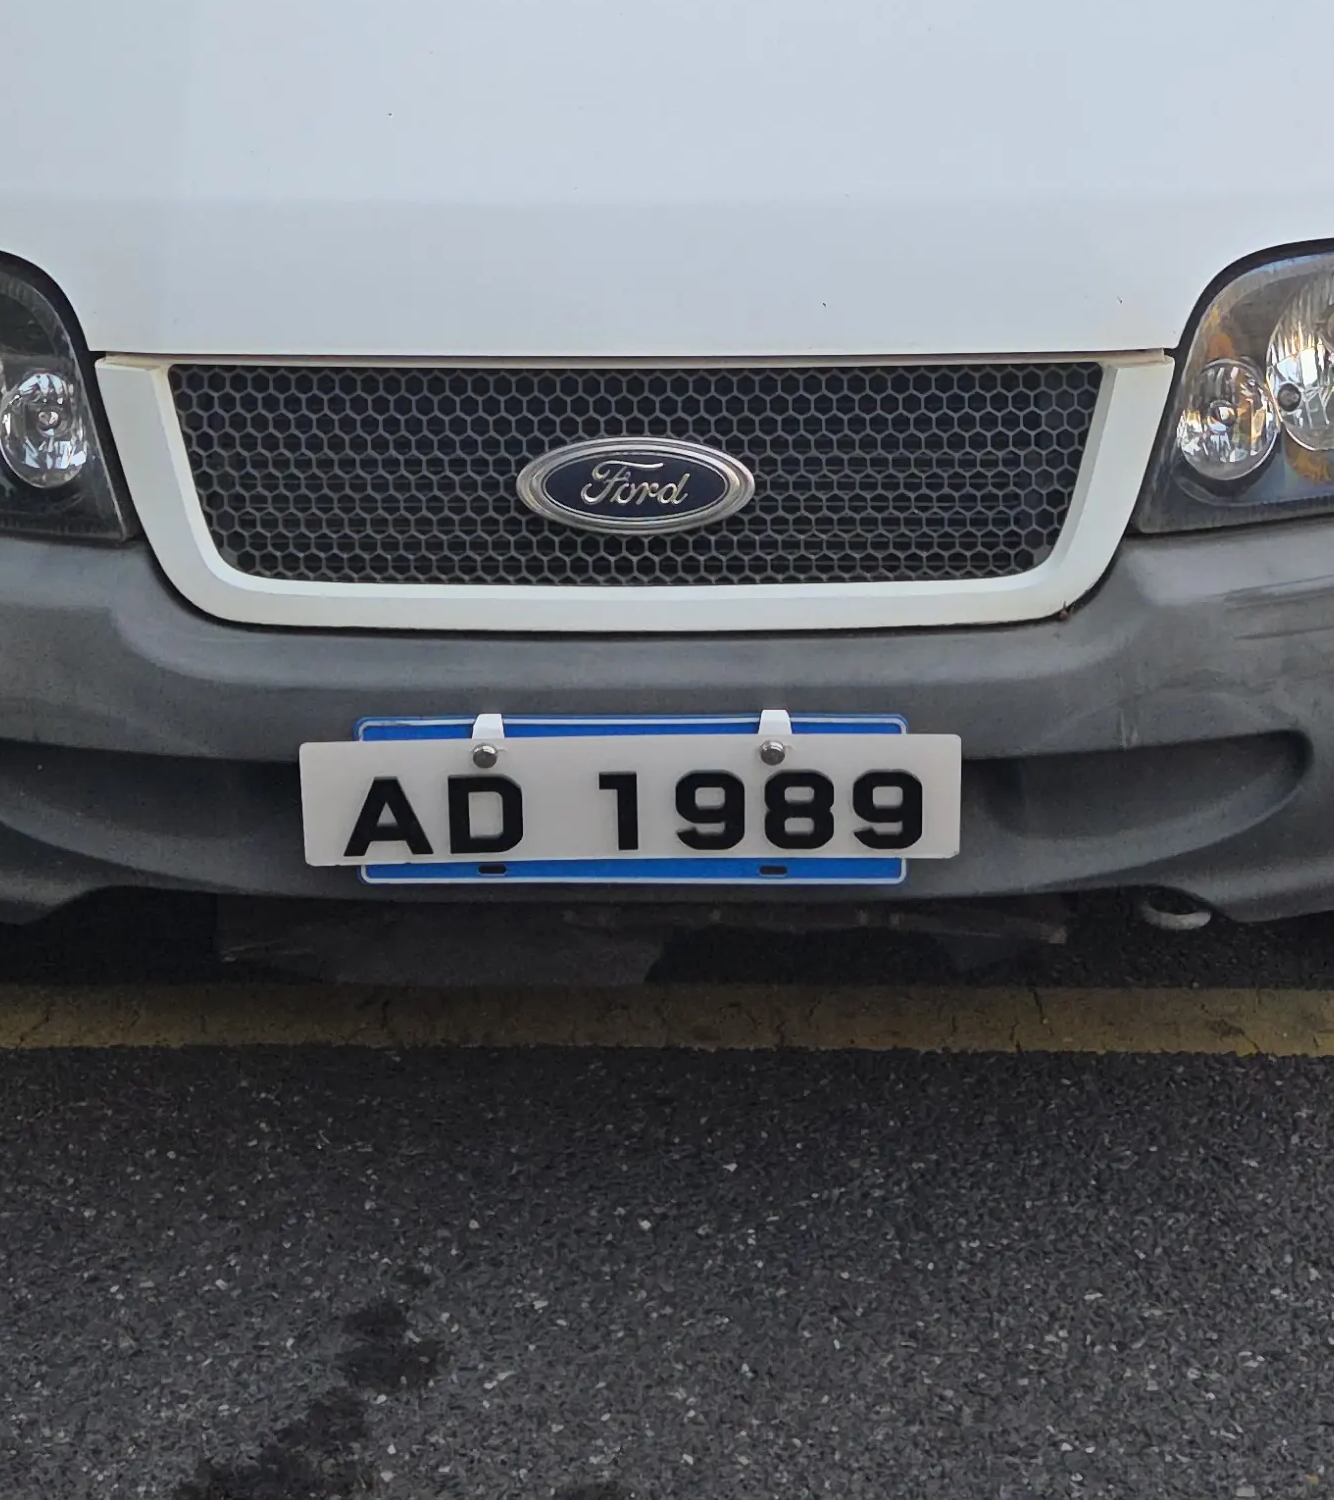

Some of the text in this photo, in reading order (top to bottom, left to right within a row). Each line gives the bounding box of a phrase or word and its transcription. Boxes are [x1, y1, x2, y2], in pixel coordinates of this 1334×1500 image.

[580, 460, 690, 505] Ford
[343, 768, 924, 858] AD 1989
